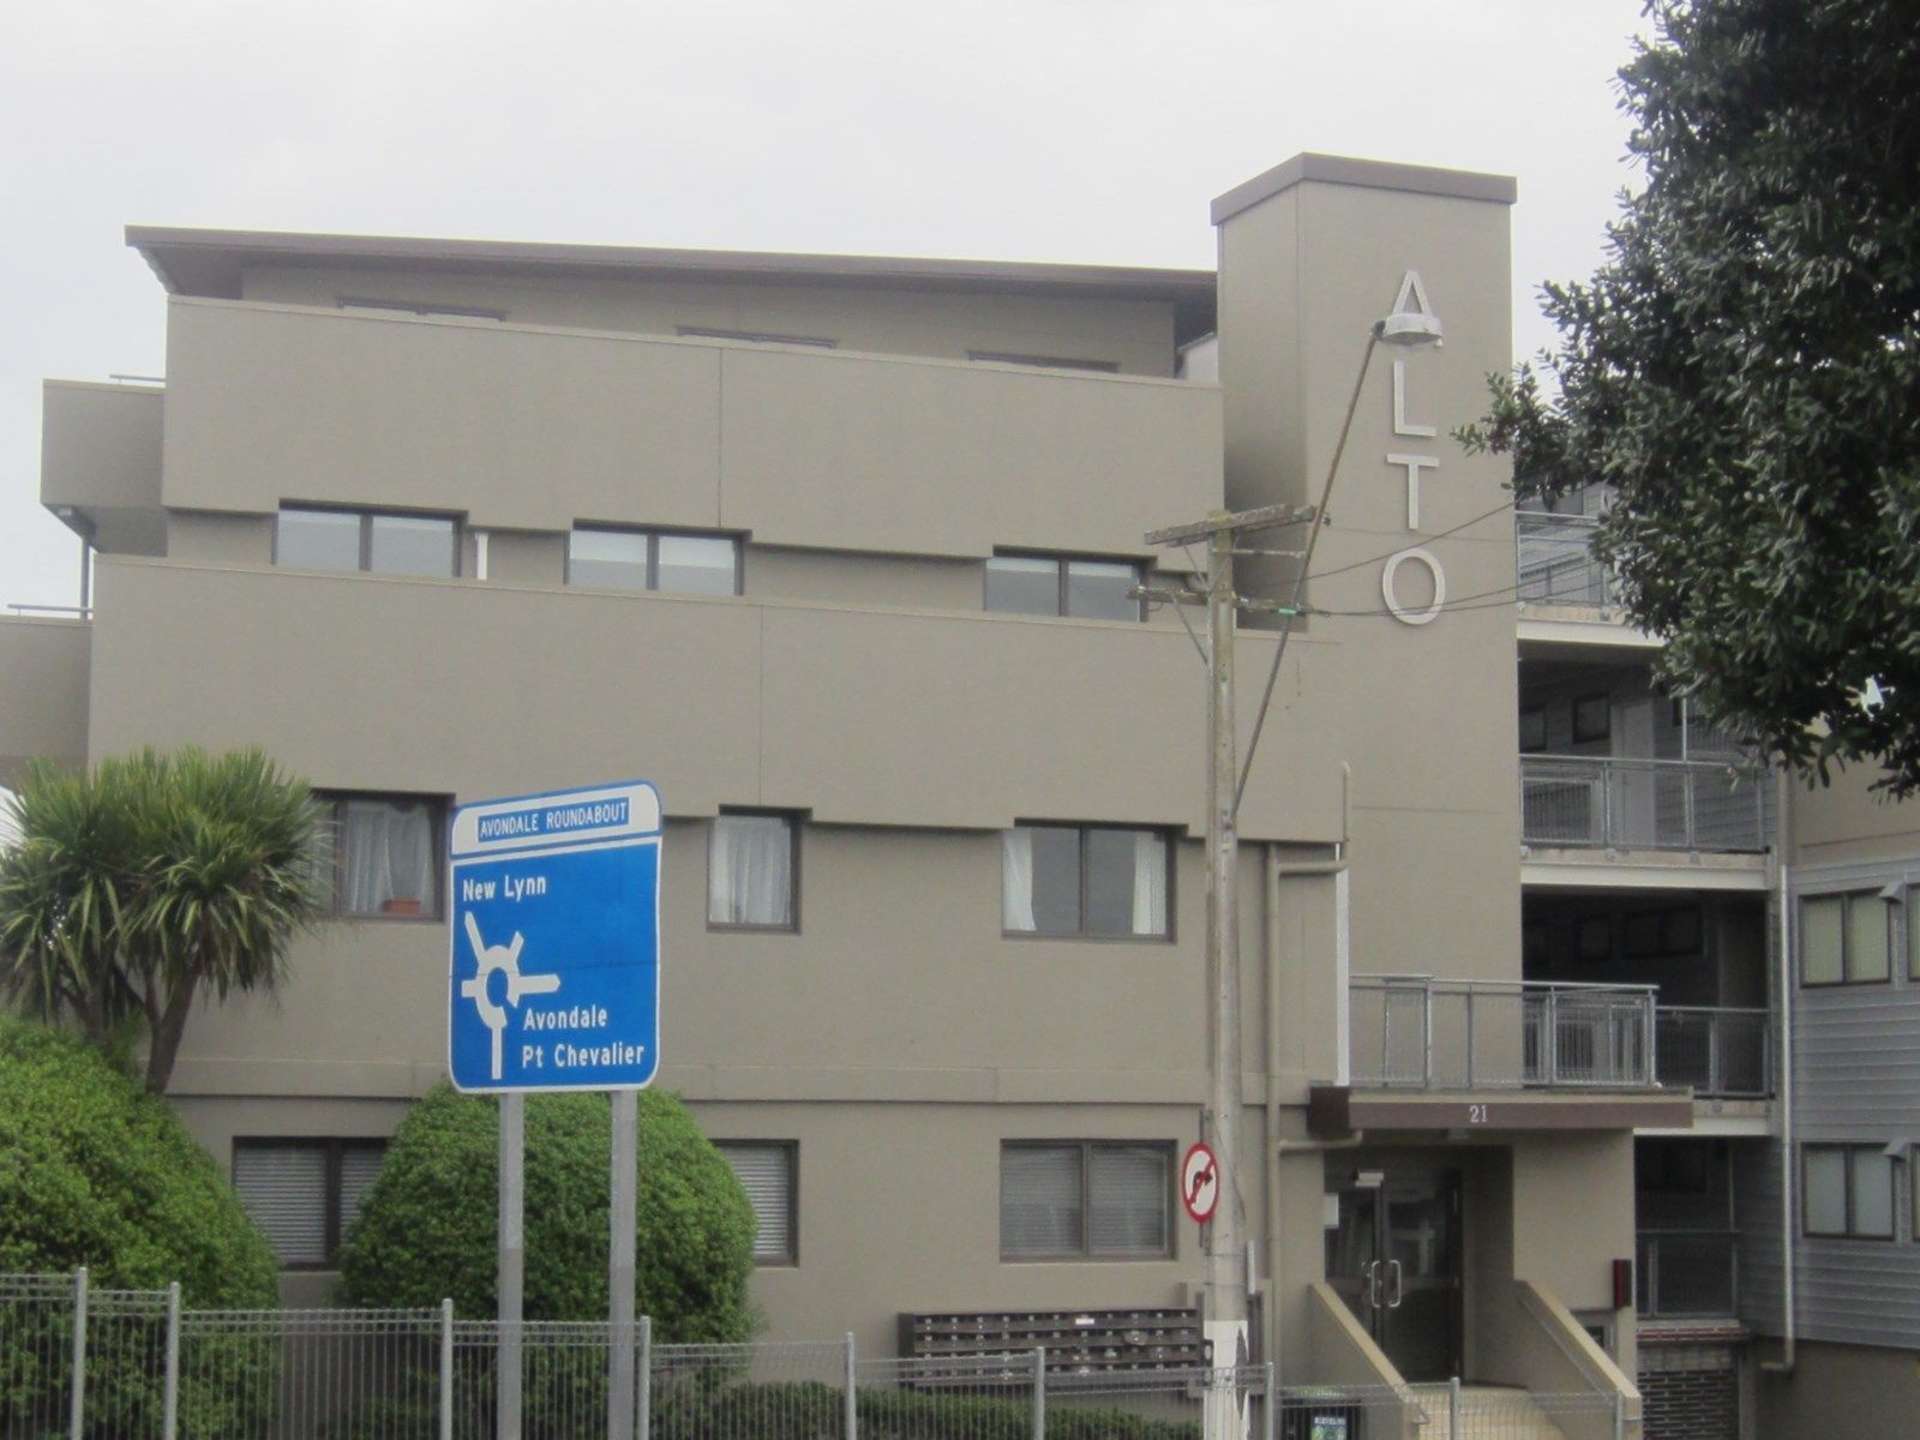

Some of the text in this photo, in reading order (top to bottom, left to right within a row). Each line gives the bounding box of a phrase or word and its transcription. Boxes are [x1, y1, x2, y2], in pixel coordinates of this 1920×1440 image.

[1382, 270, 1446, 626] ALTO
[480, 802, 627, 838] AVONDALE ROUNDABOUT
[463, 875, 547, 901] New Lynn
[523, 1005, 608, 1030] Avondale
[522, 1042, 645, 1068] Pt Chevalier
[1469, 1104, 1488, 1123] 21
